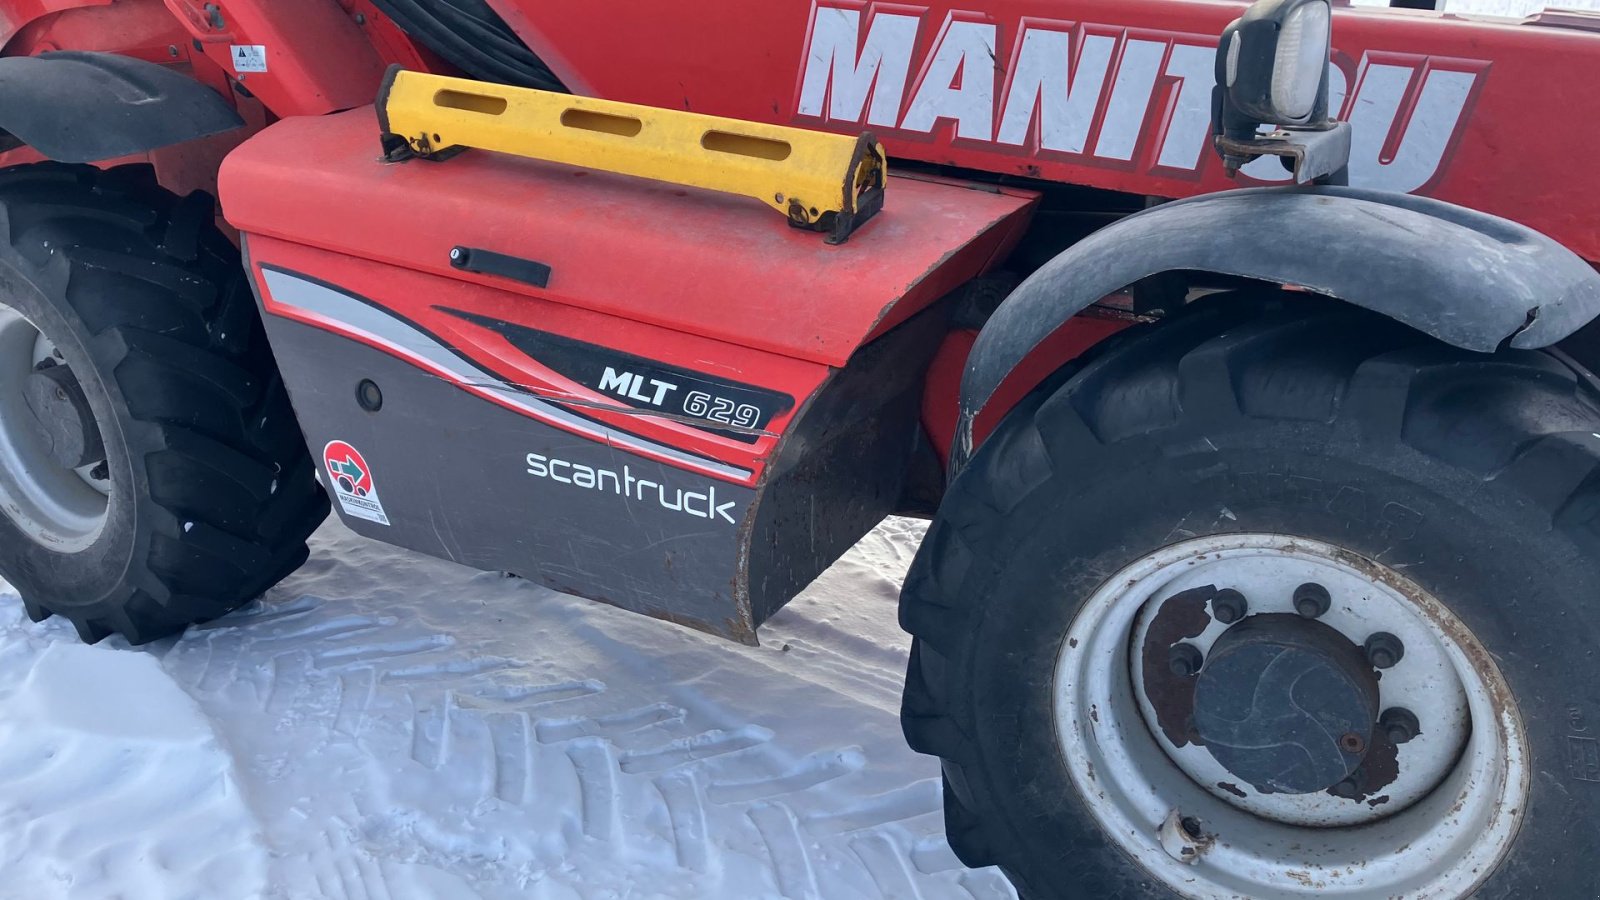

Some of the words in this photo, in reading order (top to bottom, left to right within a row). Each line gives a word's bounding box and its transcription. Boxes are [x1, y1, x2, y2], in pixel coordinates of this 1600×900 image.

[796, 4, 1488, 192] MANITU
[598, 366, 678, 406] MLT
[683, 390, 761, 430] 629
[525, 452, 736, 525] scantruck
